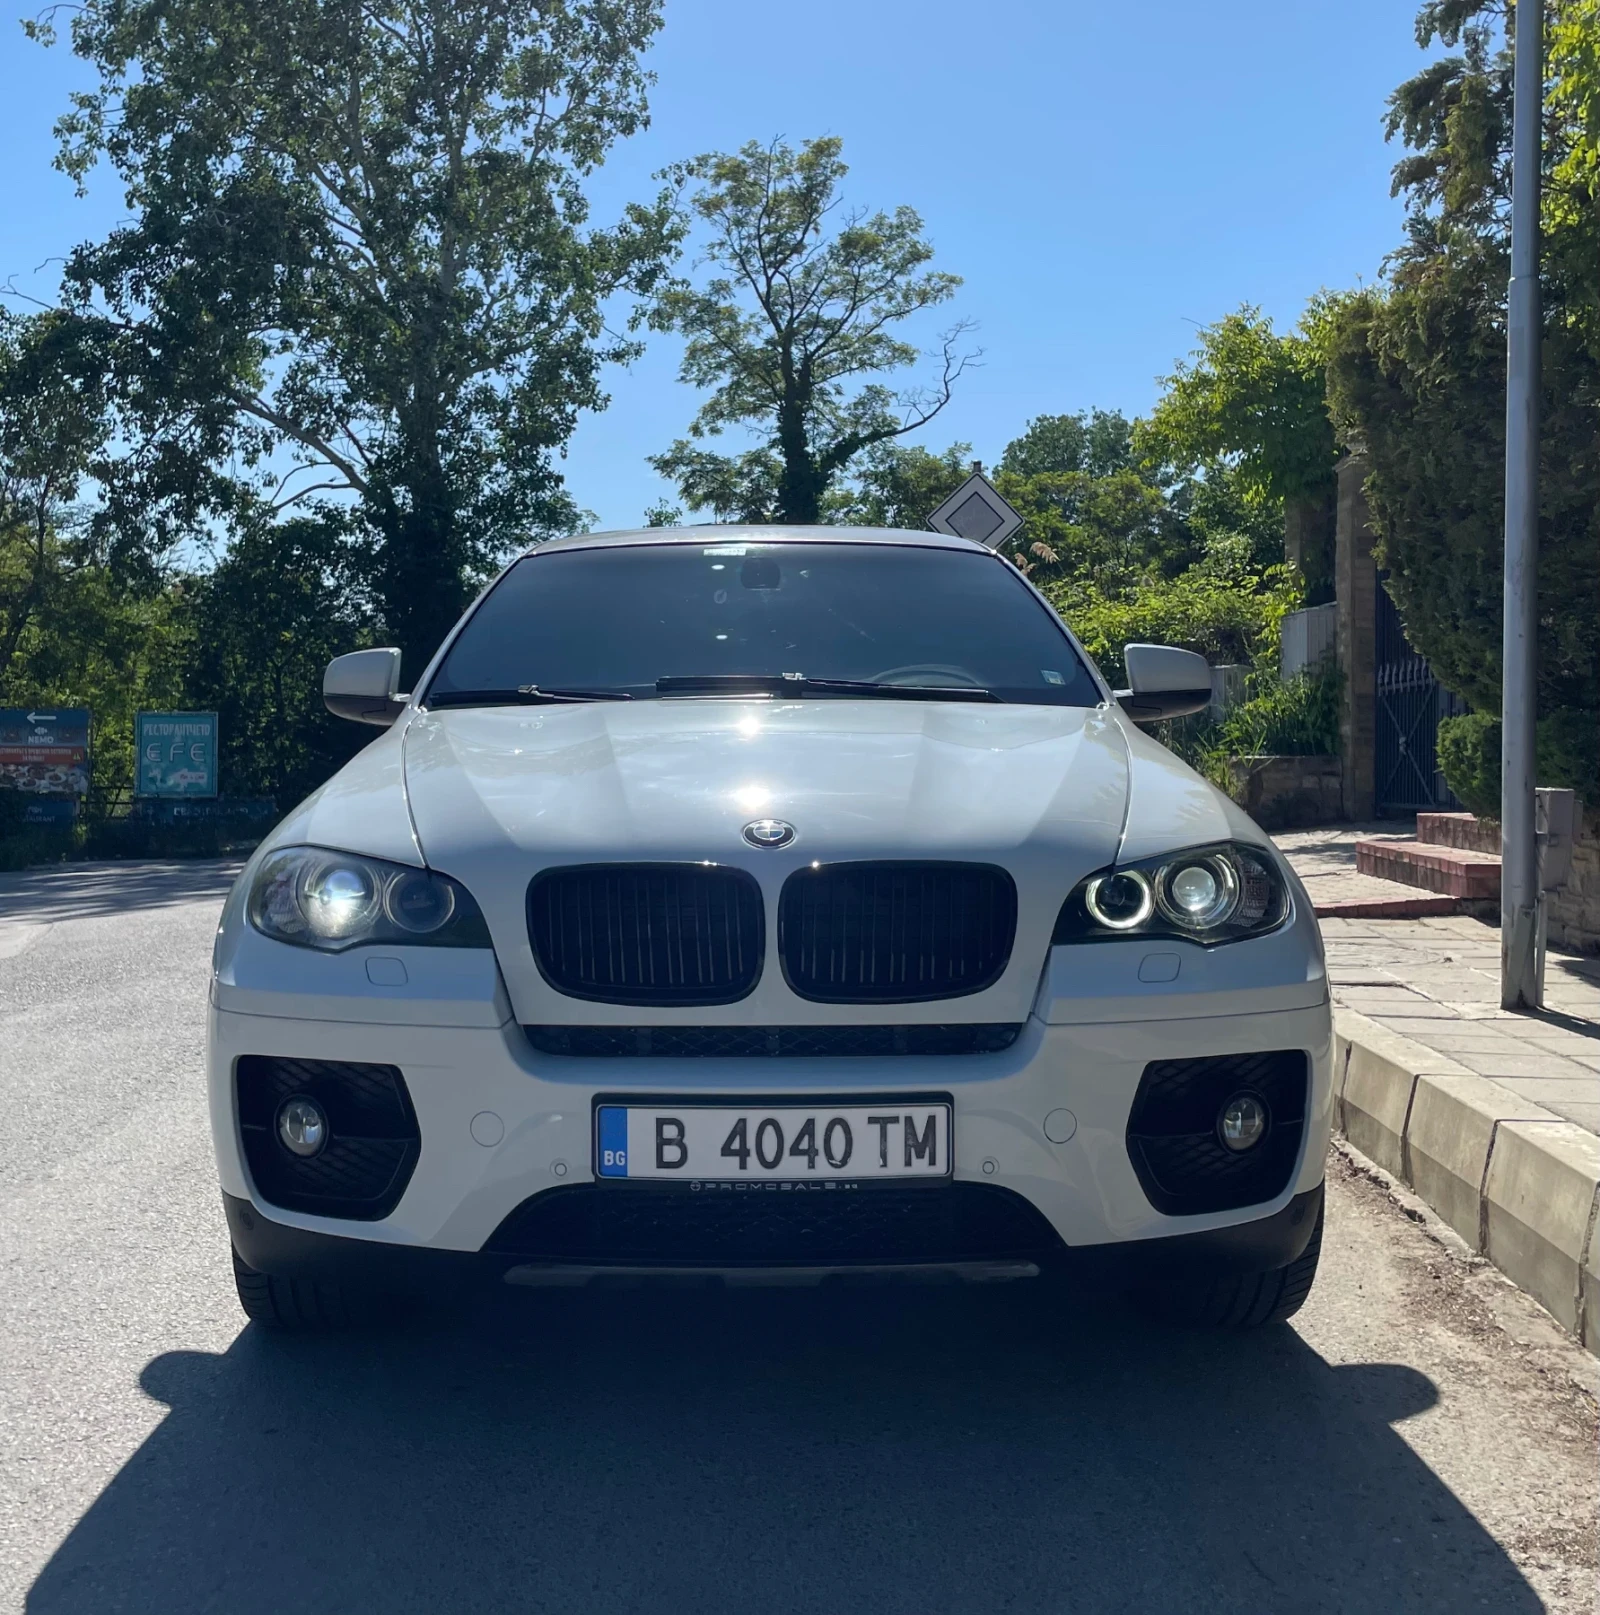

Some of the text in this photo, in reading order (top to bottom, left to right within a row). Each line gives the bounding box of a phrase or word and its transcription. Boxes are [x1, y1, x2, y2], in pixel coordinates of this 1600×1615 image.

[28, 736, 54, 744] NEMO
[655, 1115, 937, 1170] B 4040 TM
[603, 1150, 626, 1166] BG
